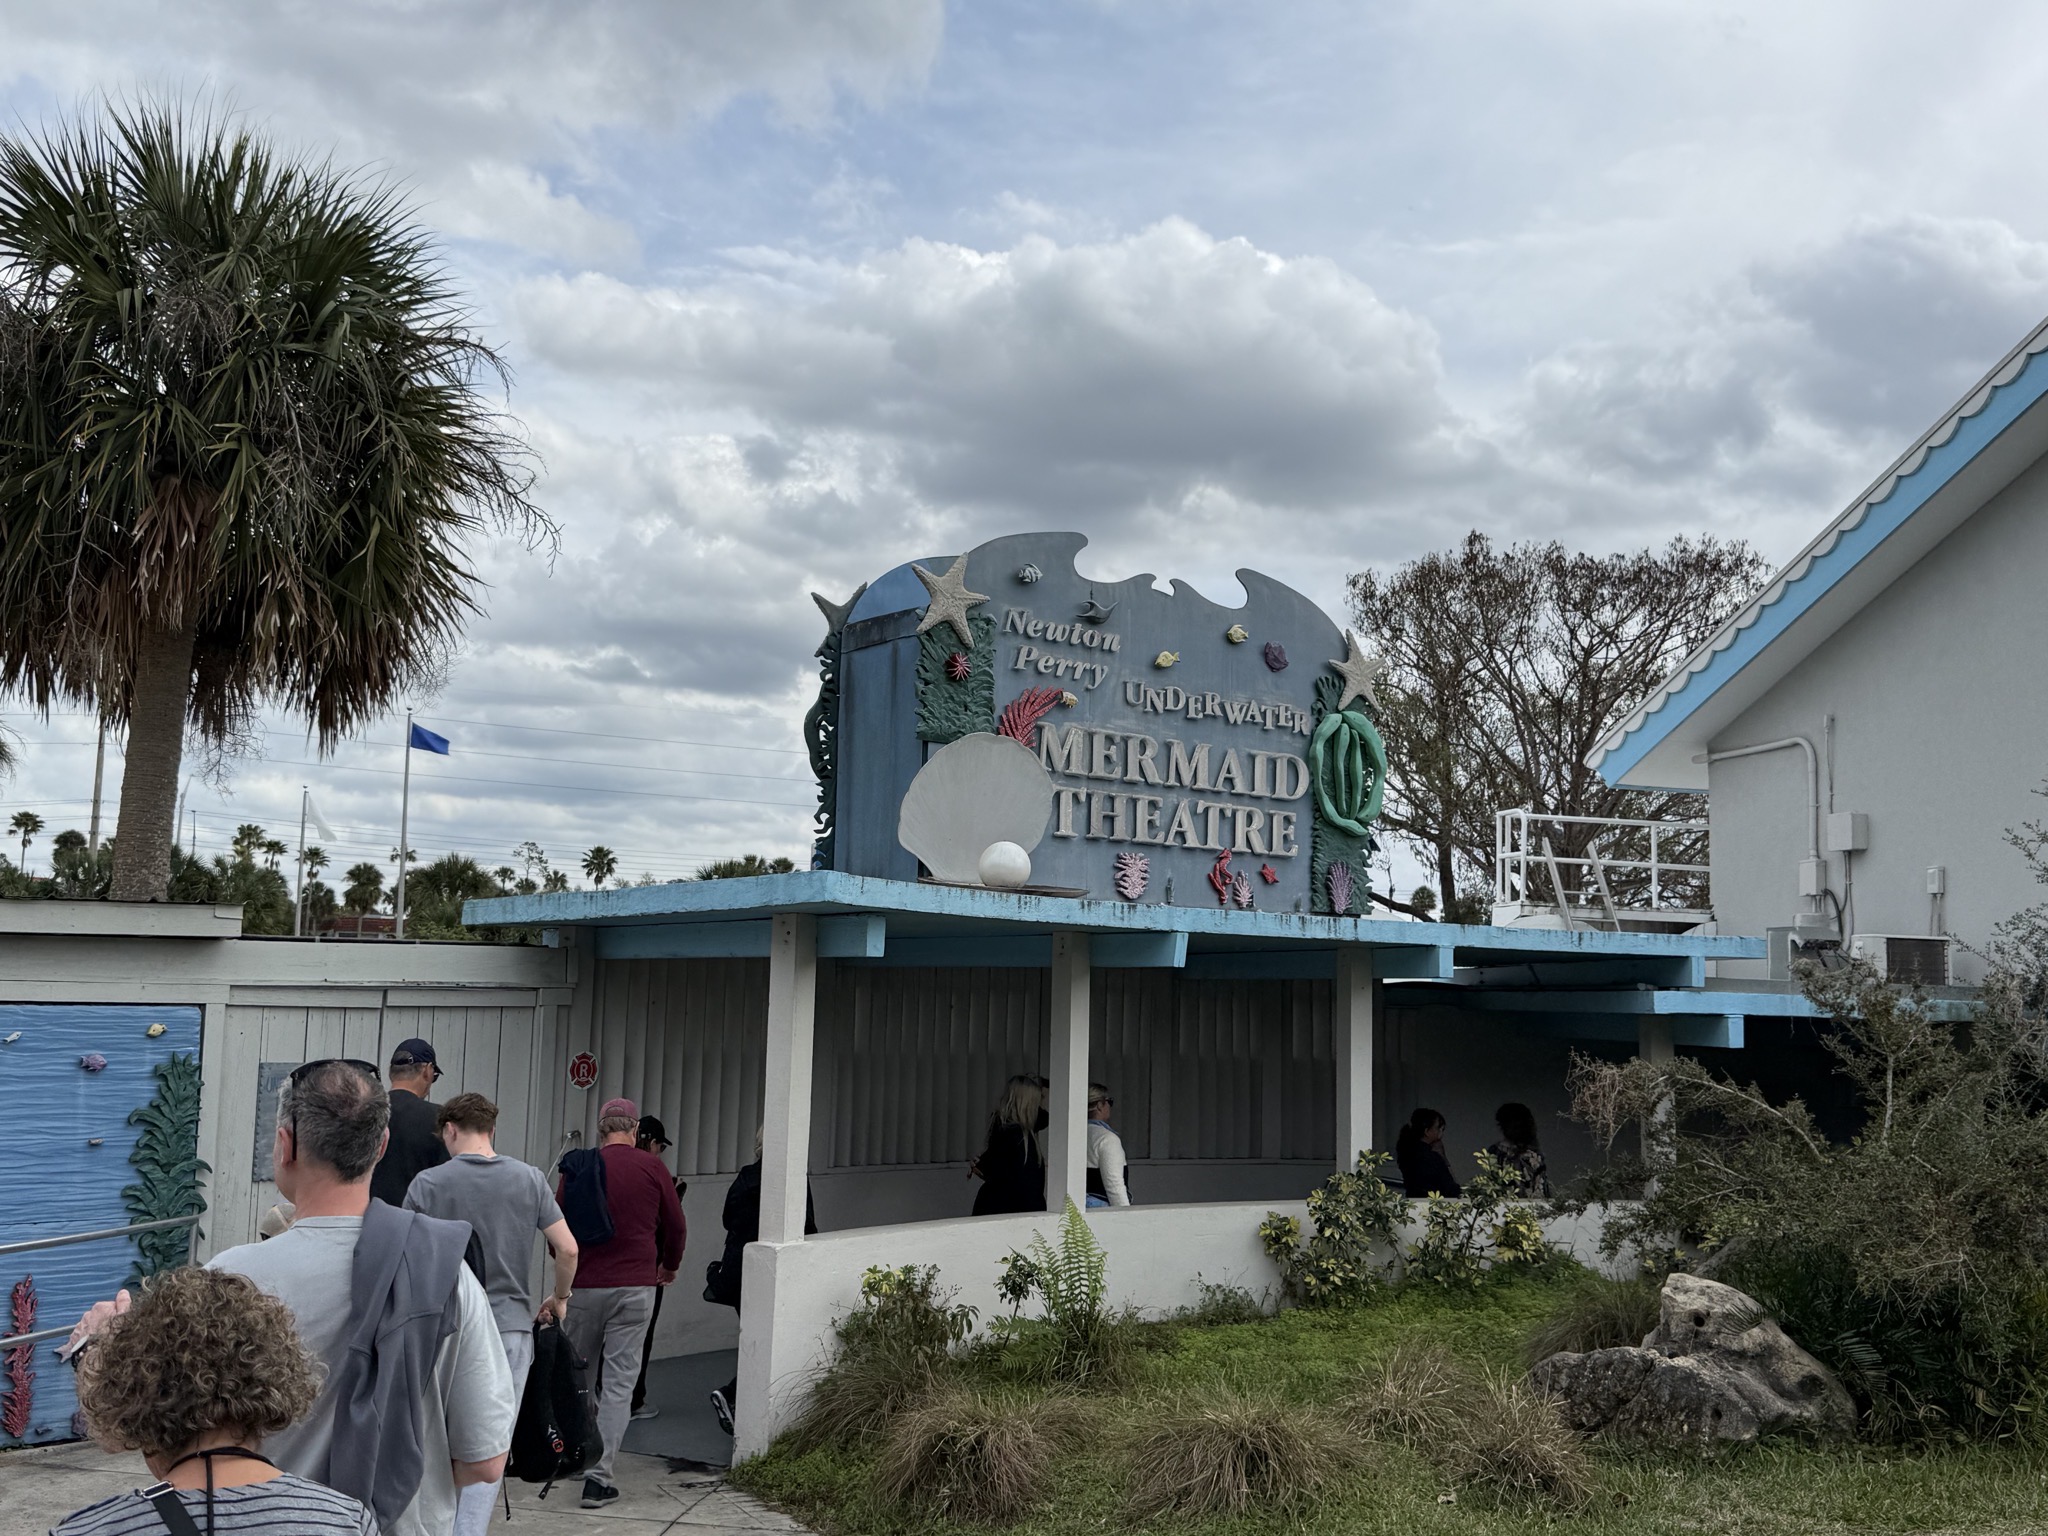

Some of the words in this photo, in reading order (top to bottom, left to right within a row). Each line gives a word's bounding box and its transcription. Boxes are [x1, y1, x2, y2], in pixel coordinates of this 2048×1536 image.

[1003, 607, 1121, 652] Newton
[1013, 644, 1109, 690] Perry
[1124, 680, 1310, 736] UNDERWATER
[1036, 721, 1310, 801] MERMAID
[1051, 785, 1299, 858] THEATRE
[580, 1063, 588, 1077] R
